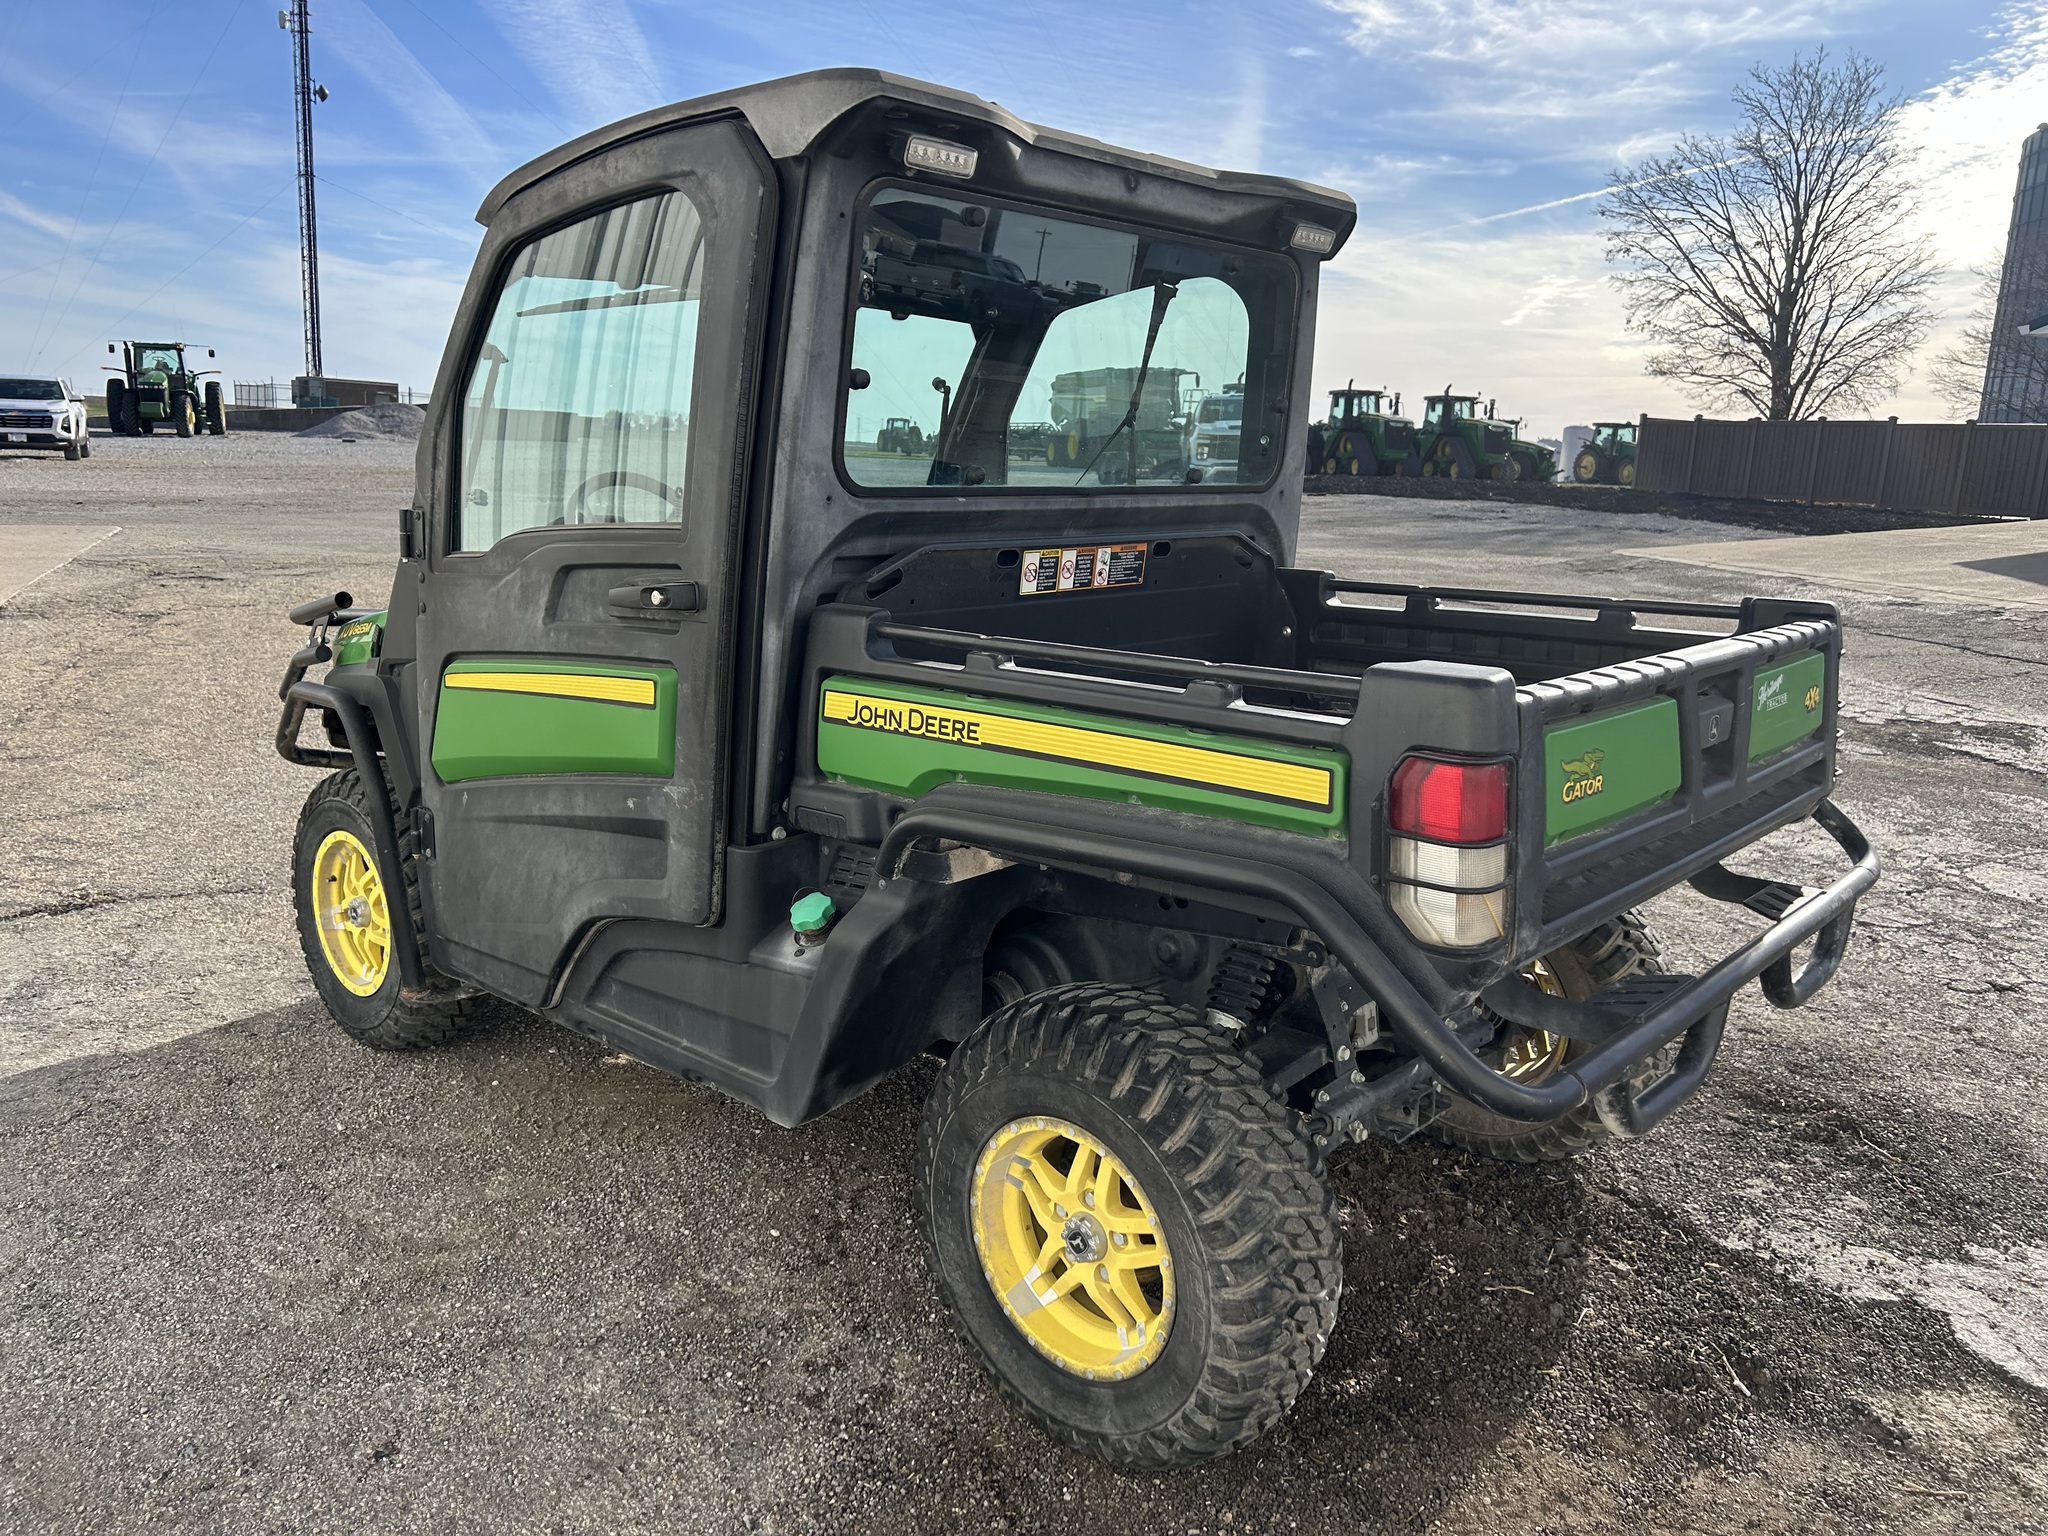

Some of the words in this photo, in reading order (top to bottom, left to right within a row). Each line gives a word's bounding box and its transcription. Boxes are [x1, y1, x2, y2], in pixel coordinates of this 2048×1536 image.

[1766, 693, 1787, 710] TRACTOR
[847, 700, 902, 729] JOHN
[908, 708, 980, 741] DEERE
[1562, 774, 1603, 803] GATOR
